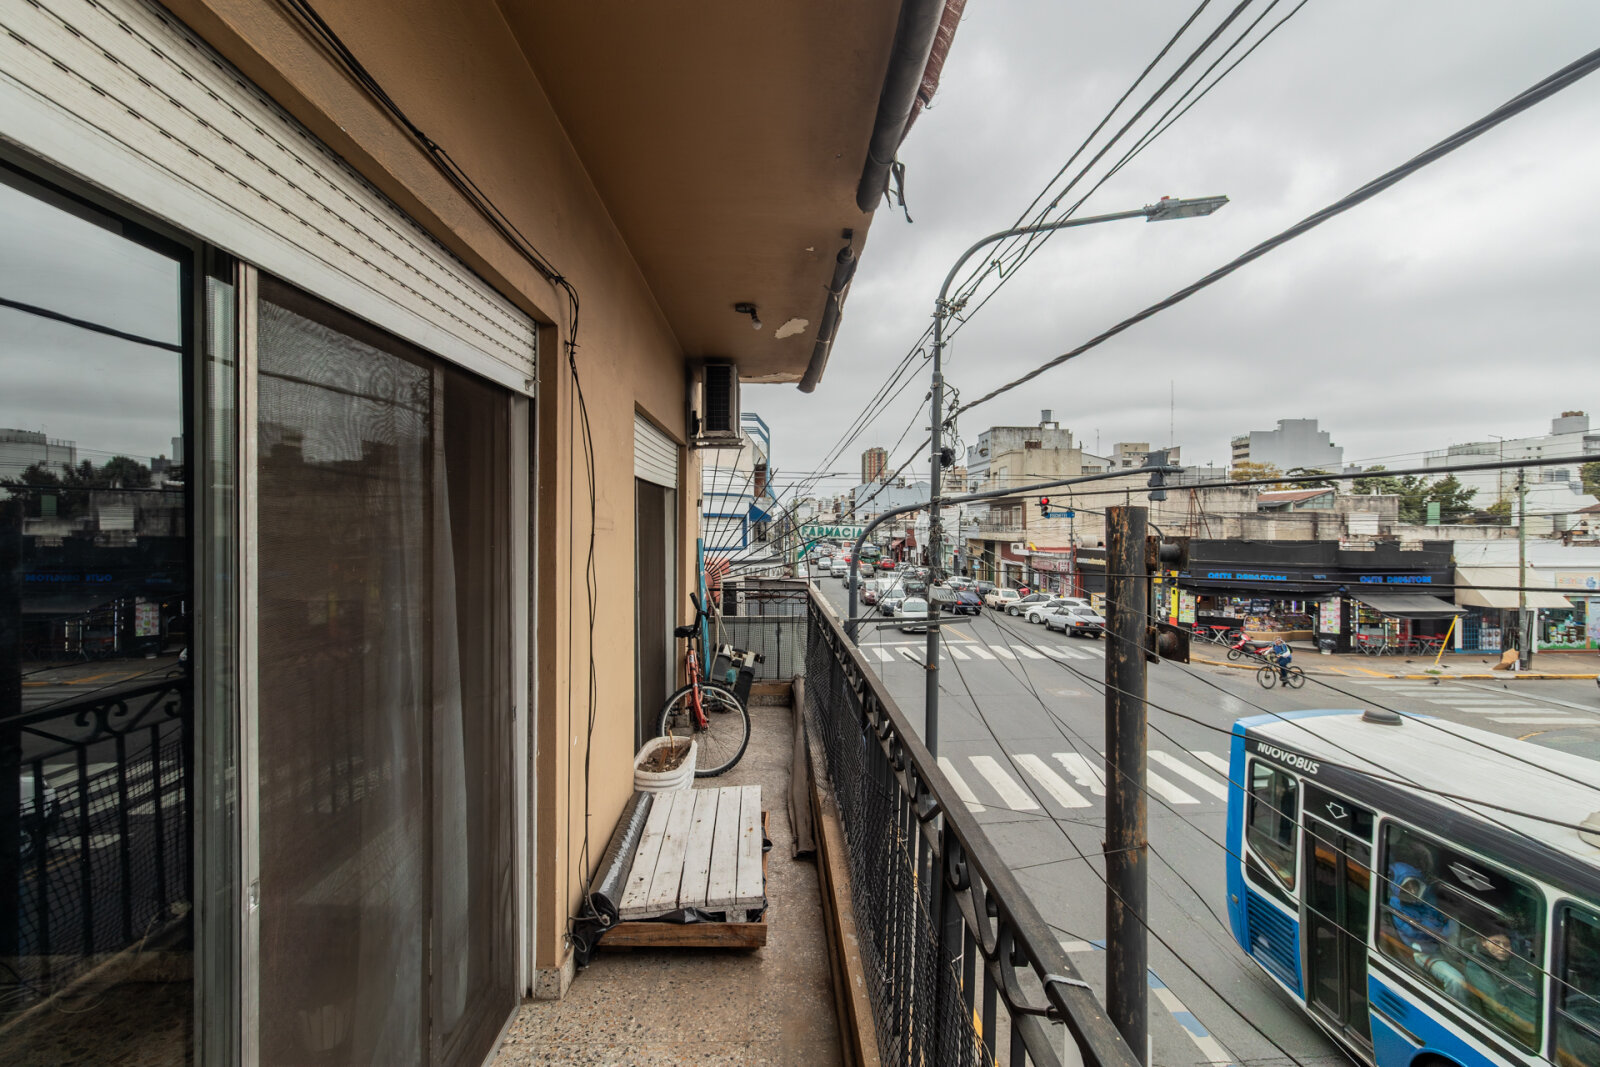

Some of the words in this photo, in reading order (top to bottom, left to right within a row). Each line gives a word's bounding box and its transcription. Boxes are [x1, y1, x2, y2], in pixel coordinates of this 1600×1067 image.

[801, 525, 864, 538] FARMACIA
[1386, 575, 1432, 584] DRUGSTORE
[1257, 742, 1320, 775] NUOVOBUS
